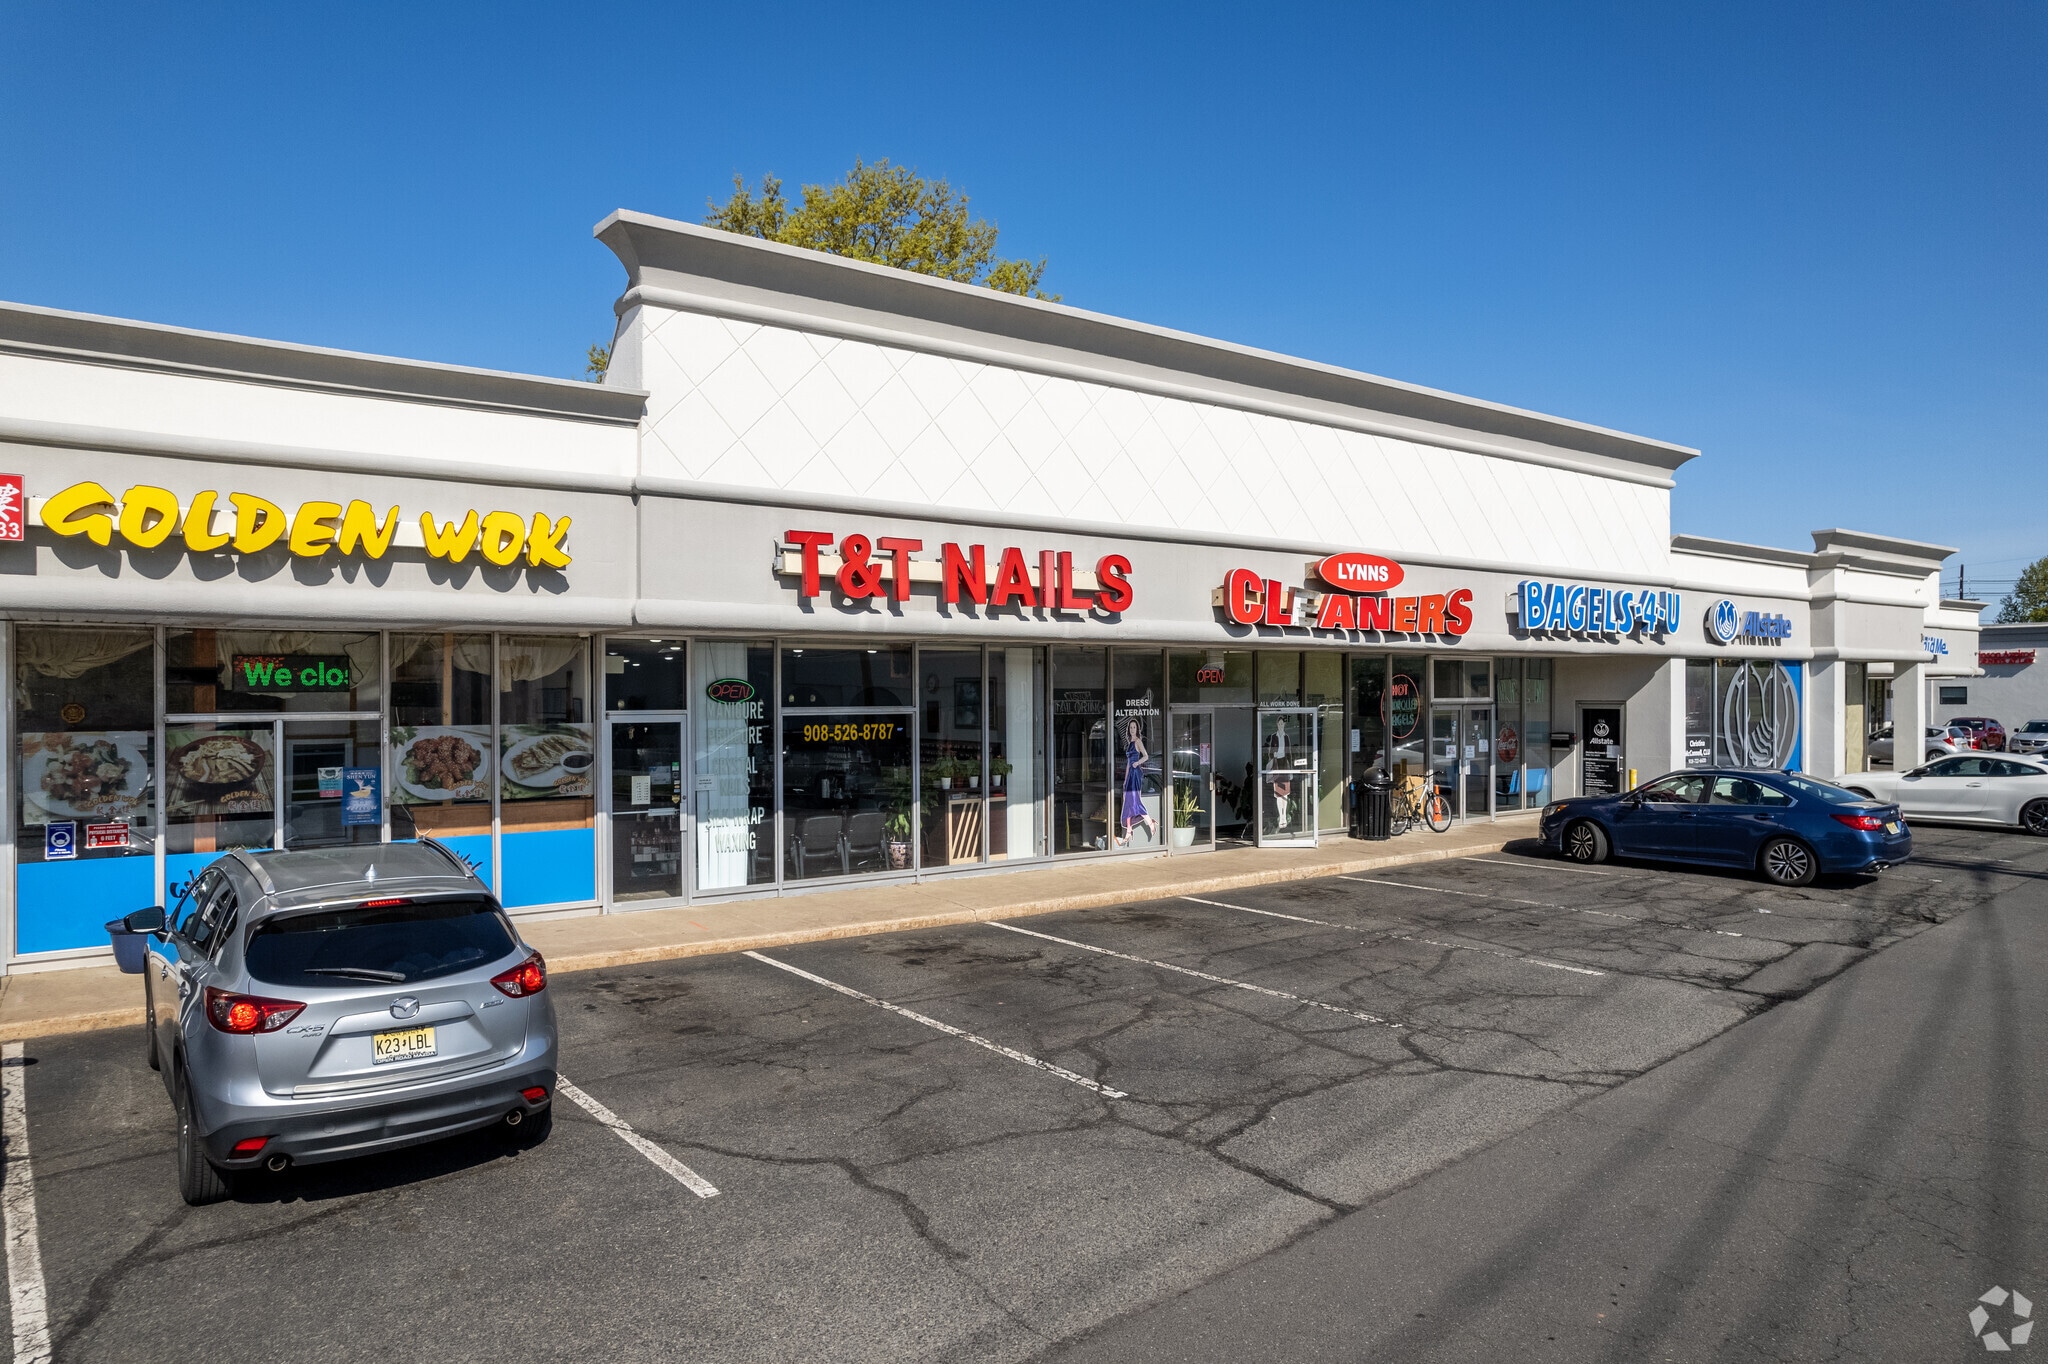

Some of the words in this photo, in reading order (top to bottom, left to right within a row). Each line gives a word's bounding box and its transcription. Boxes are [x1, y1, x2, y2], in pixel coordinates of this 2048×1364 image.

[40, 481, 400, 560] GOLDEN
[420, 509, 572, 568] WOK
[784, 530, 923, 602] T&T
[940, 542, 1133, 613] NAILS
[1337, 562, 1389, 582] LYNNS
[1224, 568, 1473, 636] CLEANERS
[1742, 611, 1792, 639] Allstate
[244, 662, 292, 686] We
[1197, 669, 1224, 683] OPEN
[710, 684, 751, 699] OPEN
[1392, 684, 1408, 696] HOT
[708, 701, 764, 720] MANICURE
[1125, 699, 1150, 707] DRESS
[1114, 708, 1160, 717] ALTERATION
[1392, 713, 1415, 726] AGELS
[804, 723, 894, 741] 908-526-8787
[1589, 737, 1614, 745] Allstate
[219, 790, 250, 803] GOLDEN
[732, 806, 765, 826] WRAP
[715, 831, 756, 853] WAXING
[286, 1024, 325, 1034] CX-5
[376, 1037, 400, 1056] K23
[408, 1033, 432, 1051] LBL
[413, 1050, 437, 1058] MAZDA
